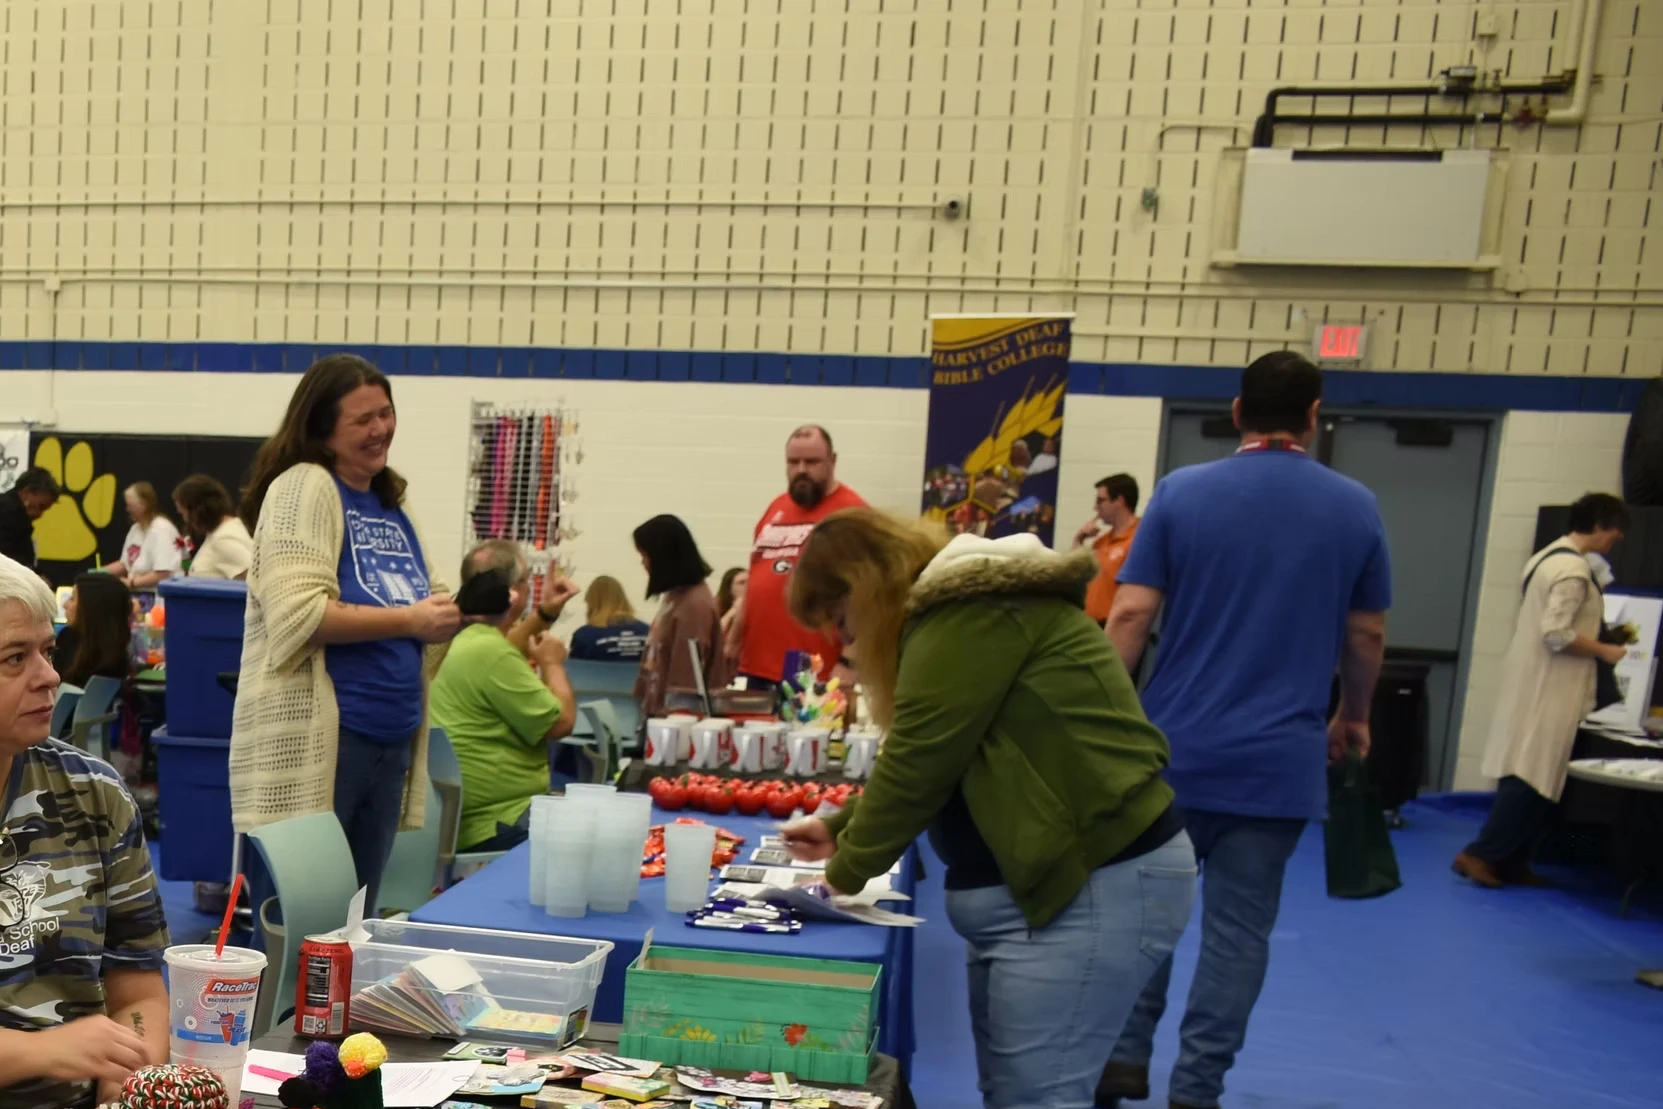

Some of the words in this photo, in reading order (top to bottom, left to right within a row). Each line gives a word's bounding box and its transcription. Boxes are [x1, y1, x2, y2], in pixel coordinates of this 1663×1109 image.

[932, 336, 1009, 367] HARVEST
[1015, 322, 1064, 348] DEAF
[1320, 327, 1362, 357] EXIT
[933, 365, 984, 386] BIBLE
[986, 341, 1070, 377] COLLEGE
[9, 917, 60, 941] School
